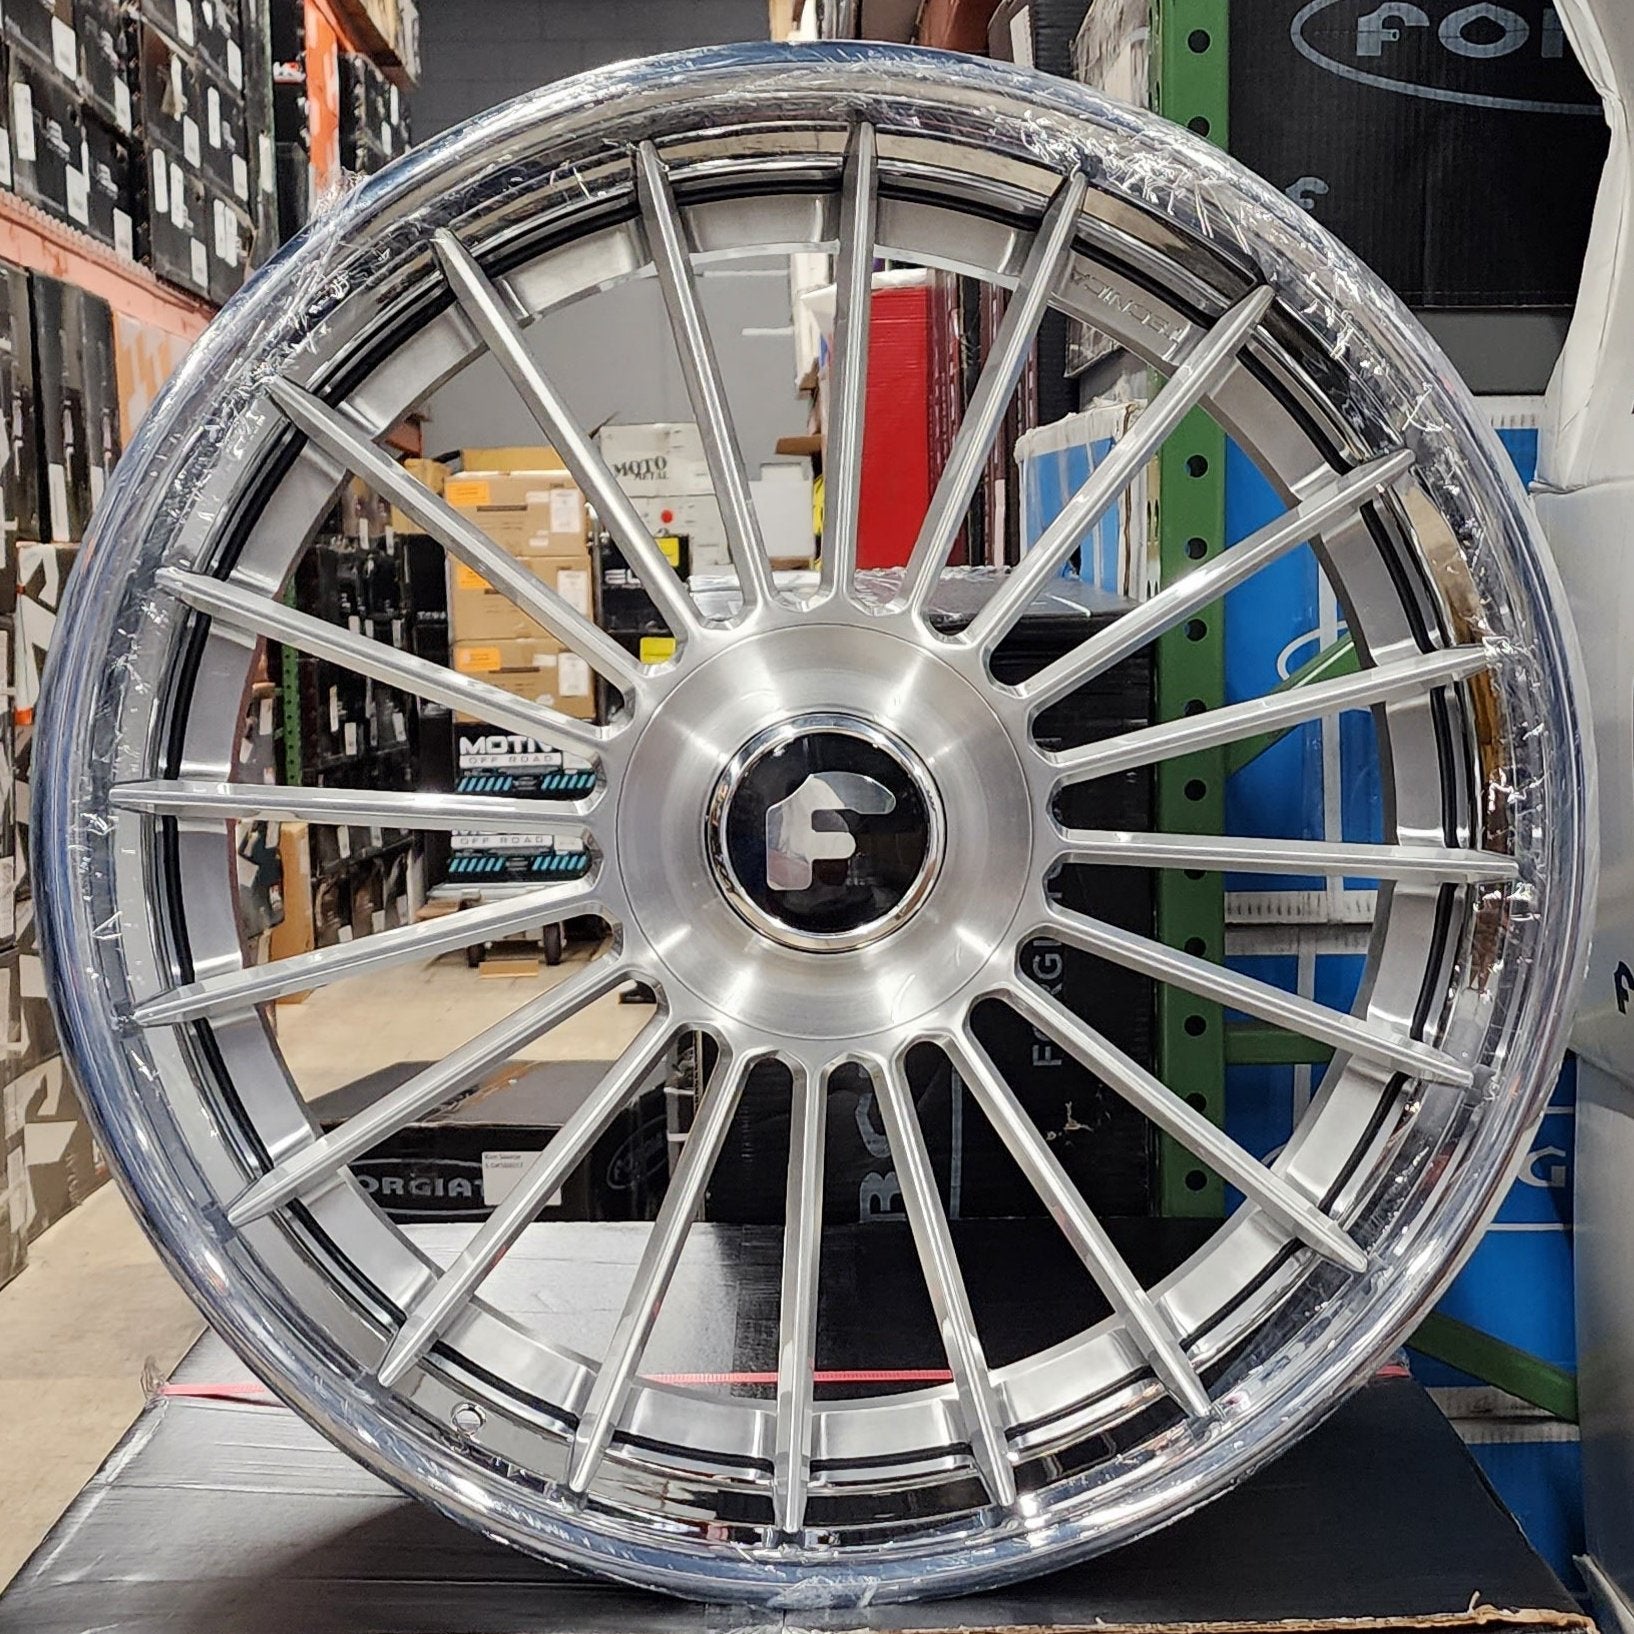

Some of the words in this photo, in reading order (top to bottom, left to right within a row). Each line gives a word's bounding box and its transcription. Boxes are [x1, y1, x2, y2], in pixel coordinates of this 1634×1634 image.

[612, 455, 668, 477] MOTO
[468, 756, 499, 764] OFF
[508, 755, 553, 763] ROAD
[460, 837, 490, 845] OFF
[500, 836, 544, 844] ROAD
